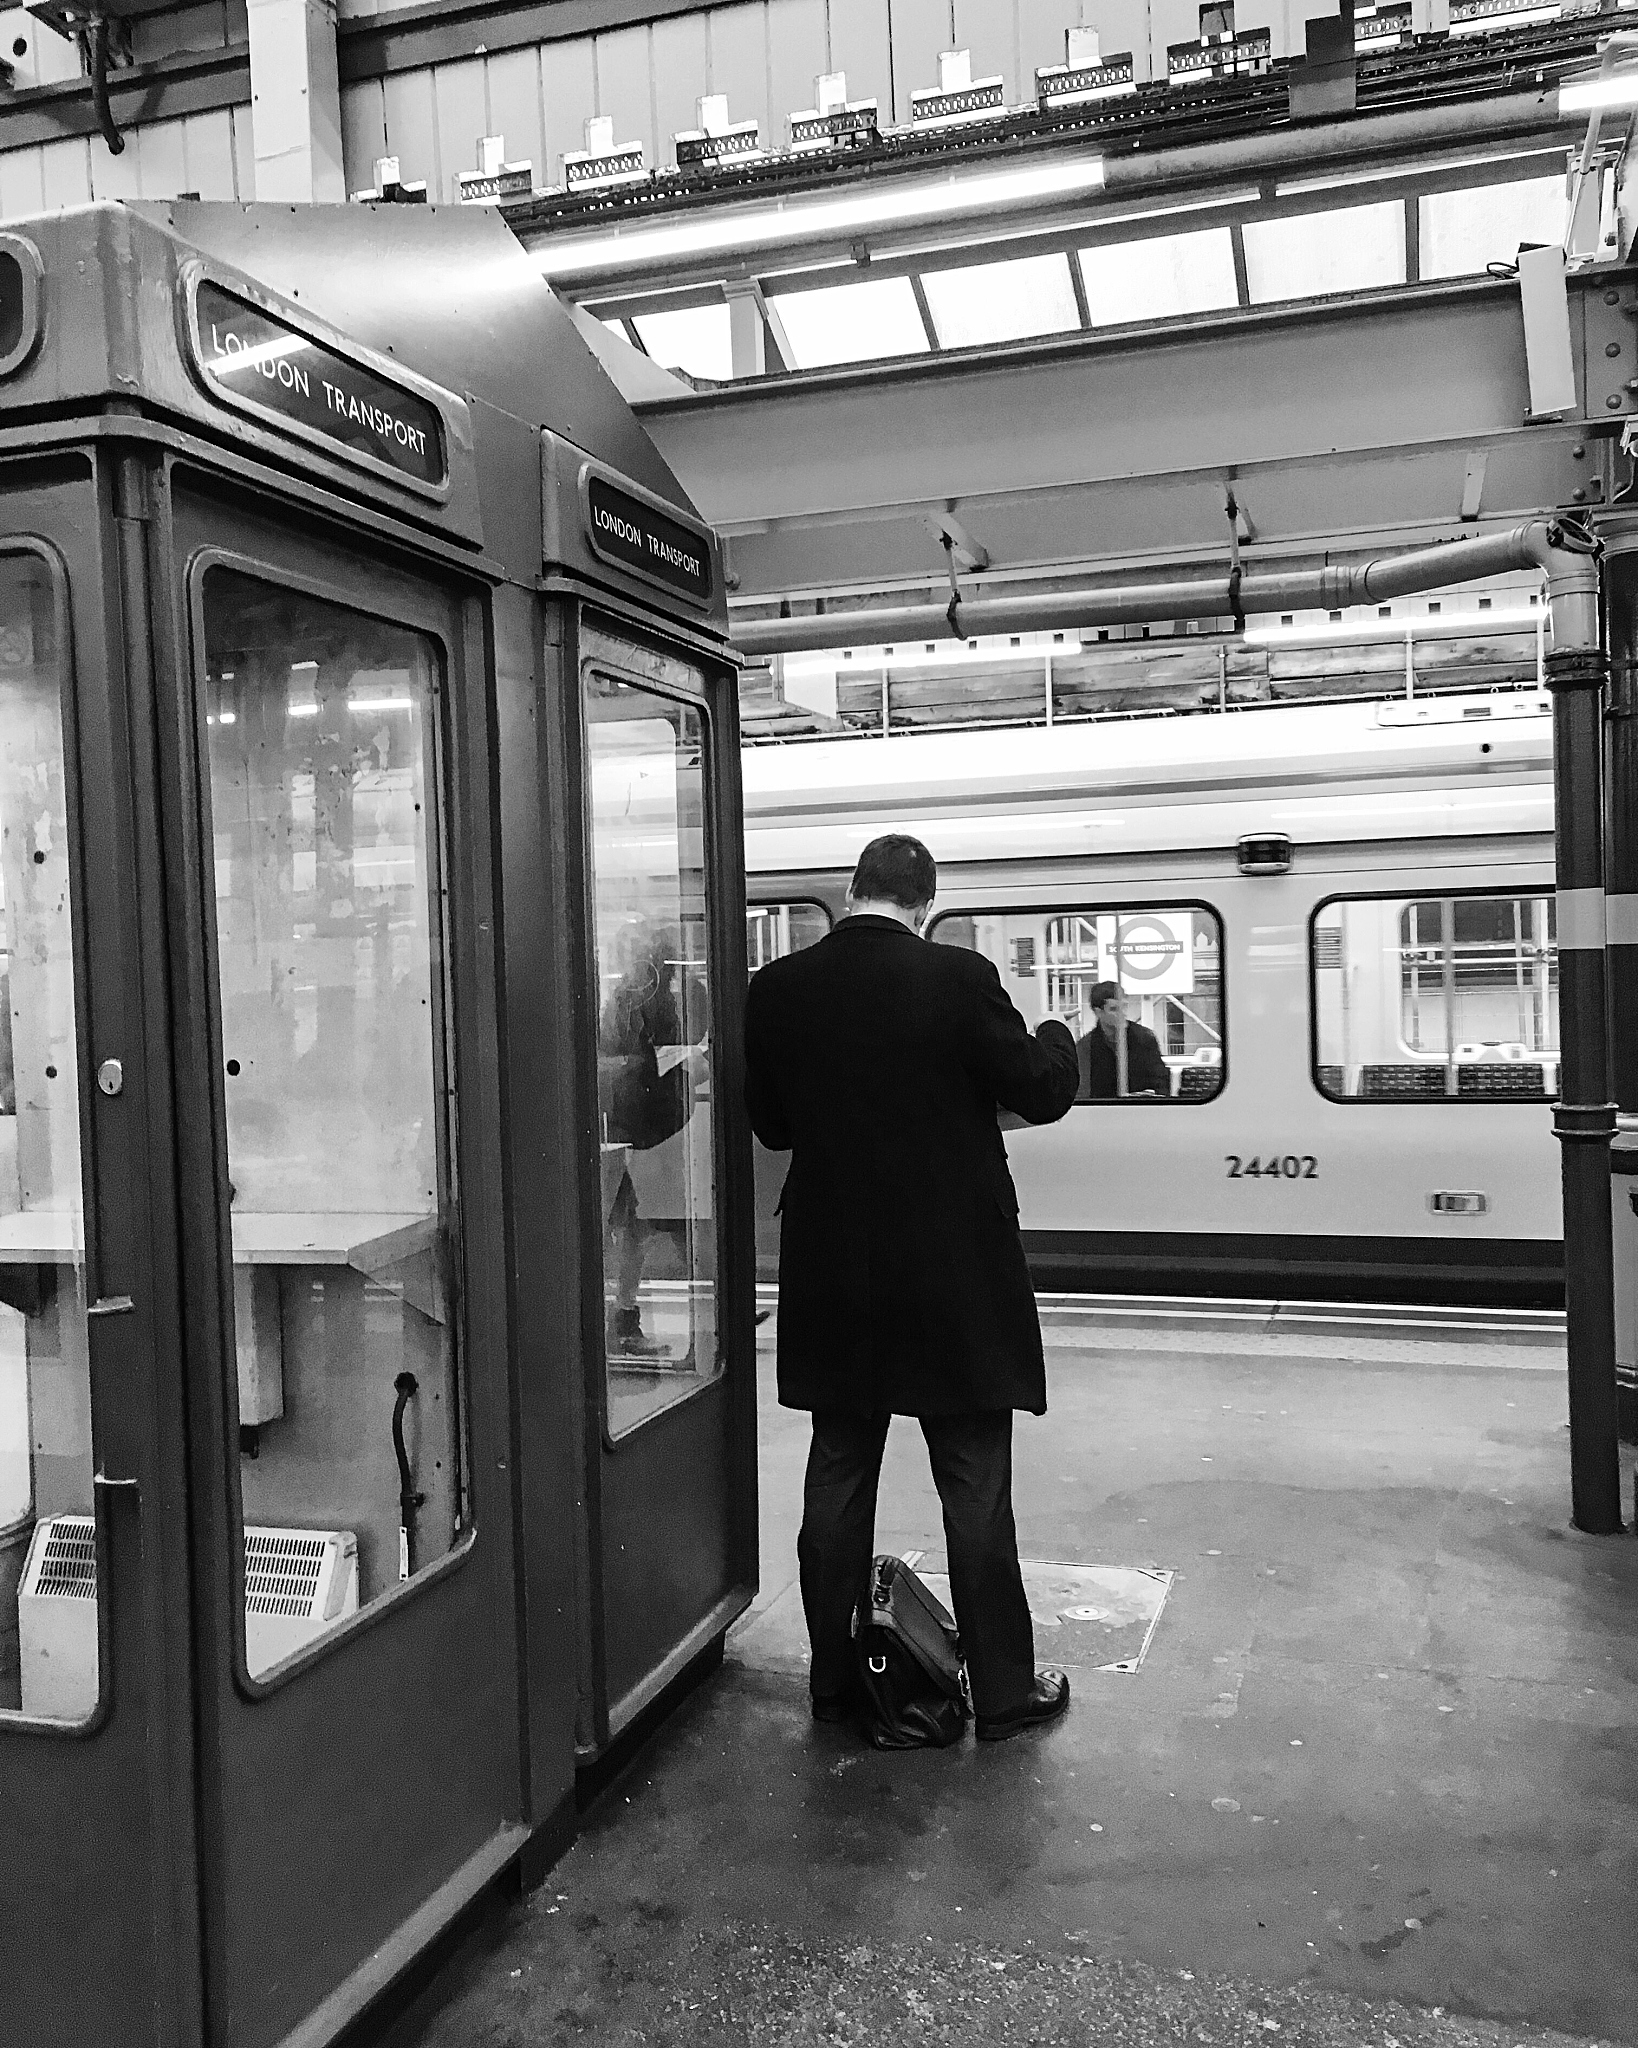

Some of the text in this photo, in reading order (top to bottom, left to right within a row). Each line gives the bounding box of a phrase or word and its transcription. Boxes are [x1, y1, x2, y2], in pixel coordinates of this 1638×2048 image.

[322, 380, 426, 455] TRANSPORT
[594, 505, 700, 577] LONDON TRANSPORT
[1135, 944, 1180, 952] KENSINGTON
[1224, 1155, 1319, 1179] 24402
